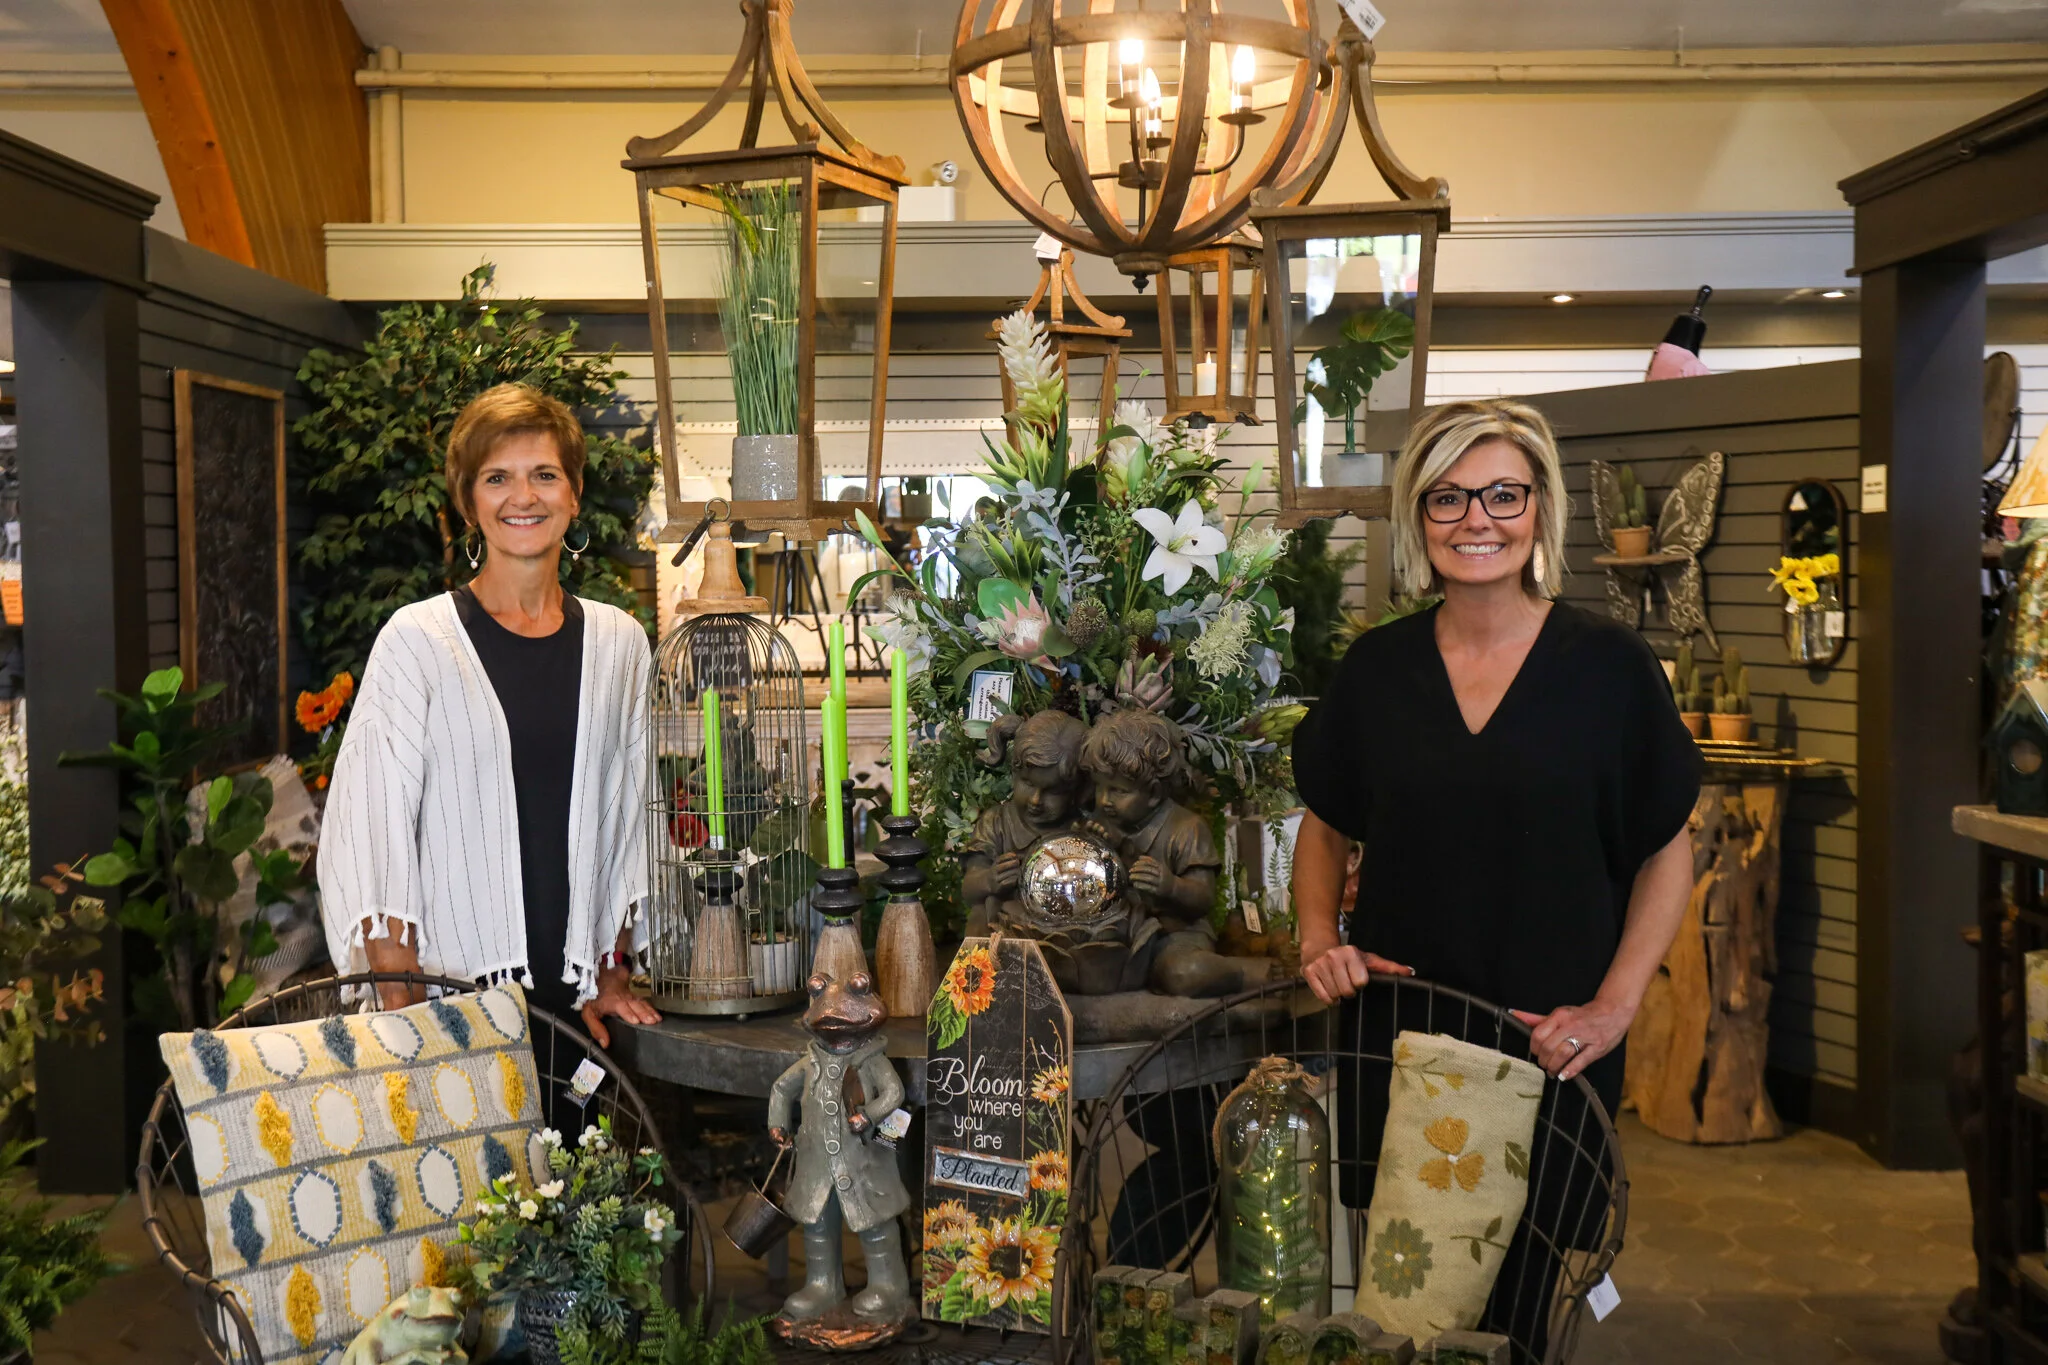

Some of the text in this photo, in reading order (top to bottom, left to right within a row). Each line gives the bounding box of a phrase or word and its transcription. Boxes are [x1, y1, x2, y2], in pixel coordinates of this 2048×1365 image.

[926, 1054, 1028, 1105] Bloom
[970, 1097, 1022, 1117] where
[953, 1114, 983, 1138] you
[973, 1133, 1002, 1150] are
[941, 1157, 1020, 1191] Planted
